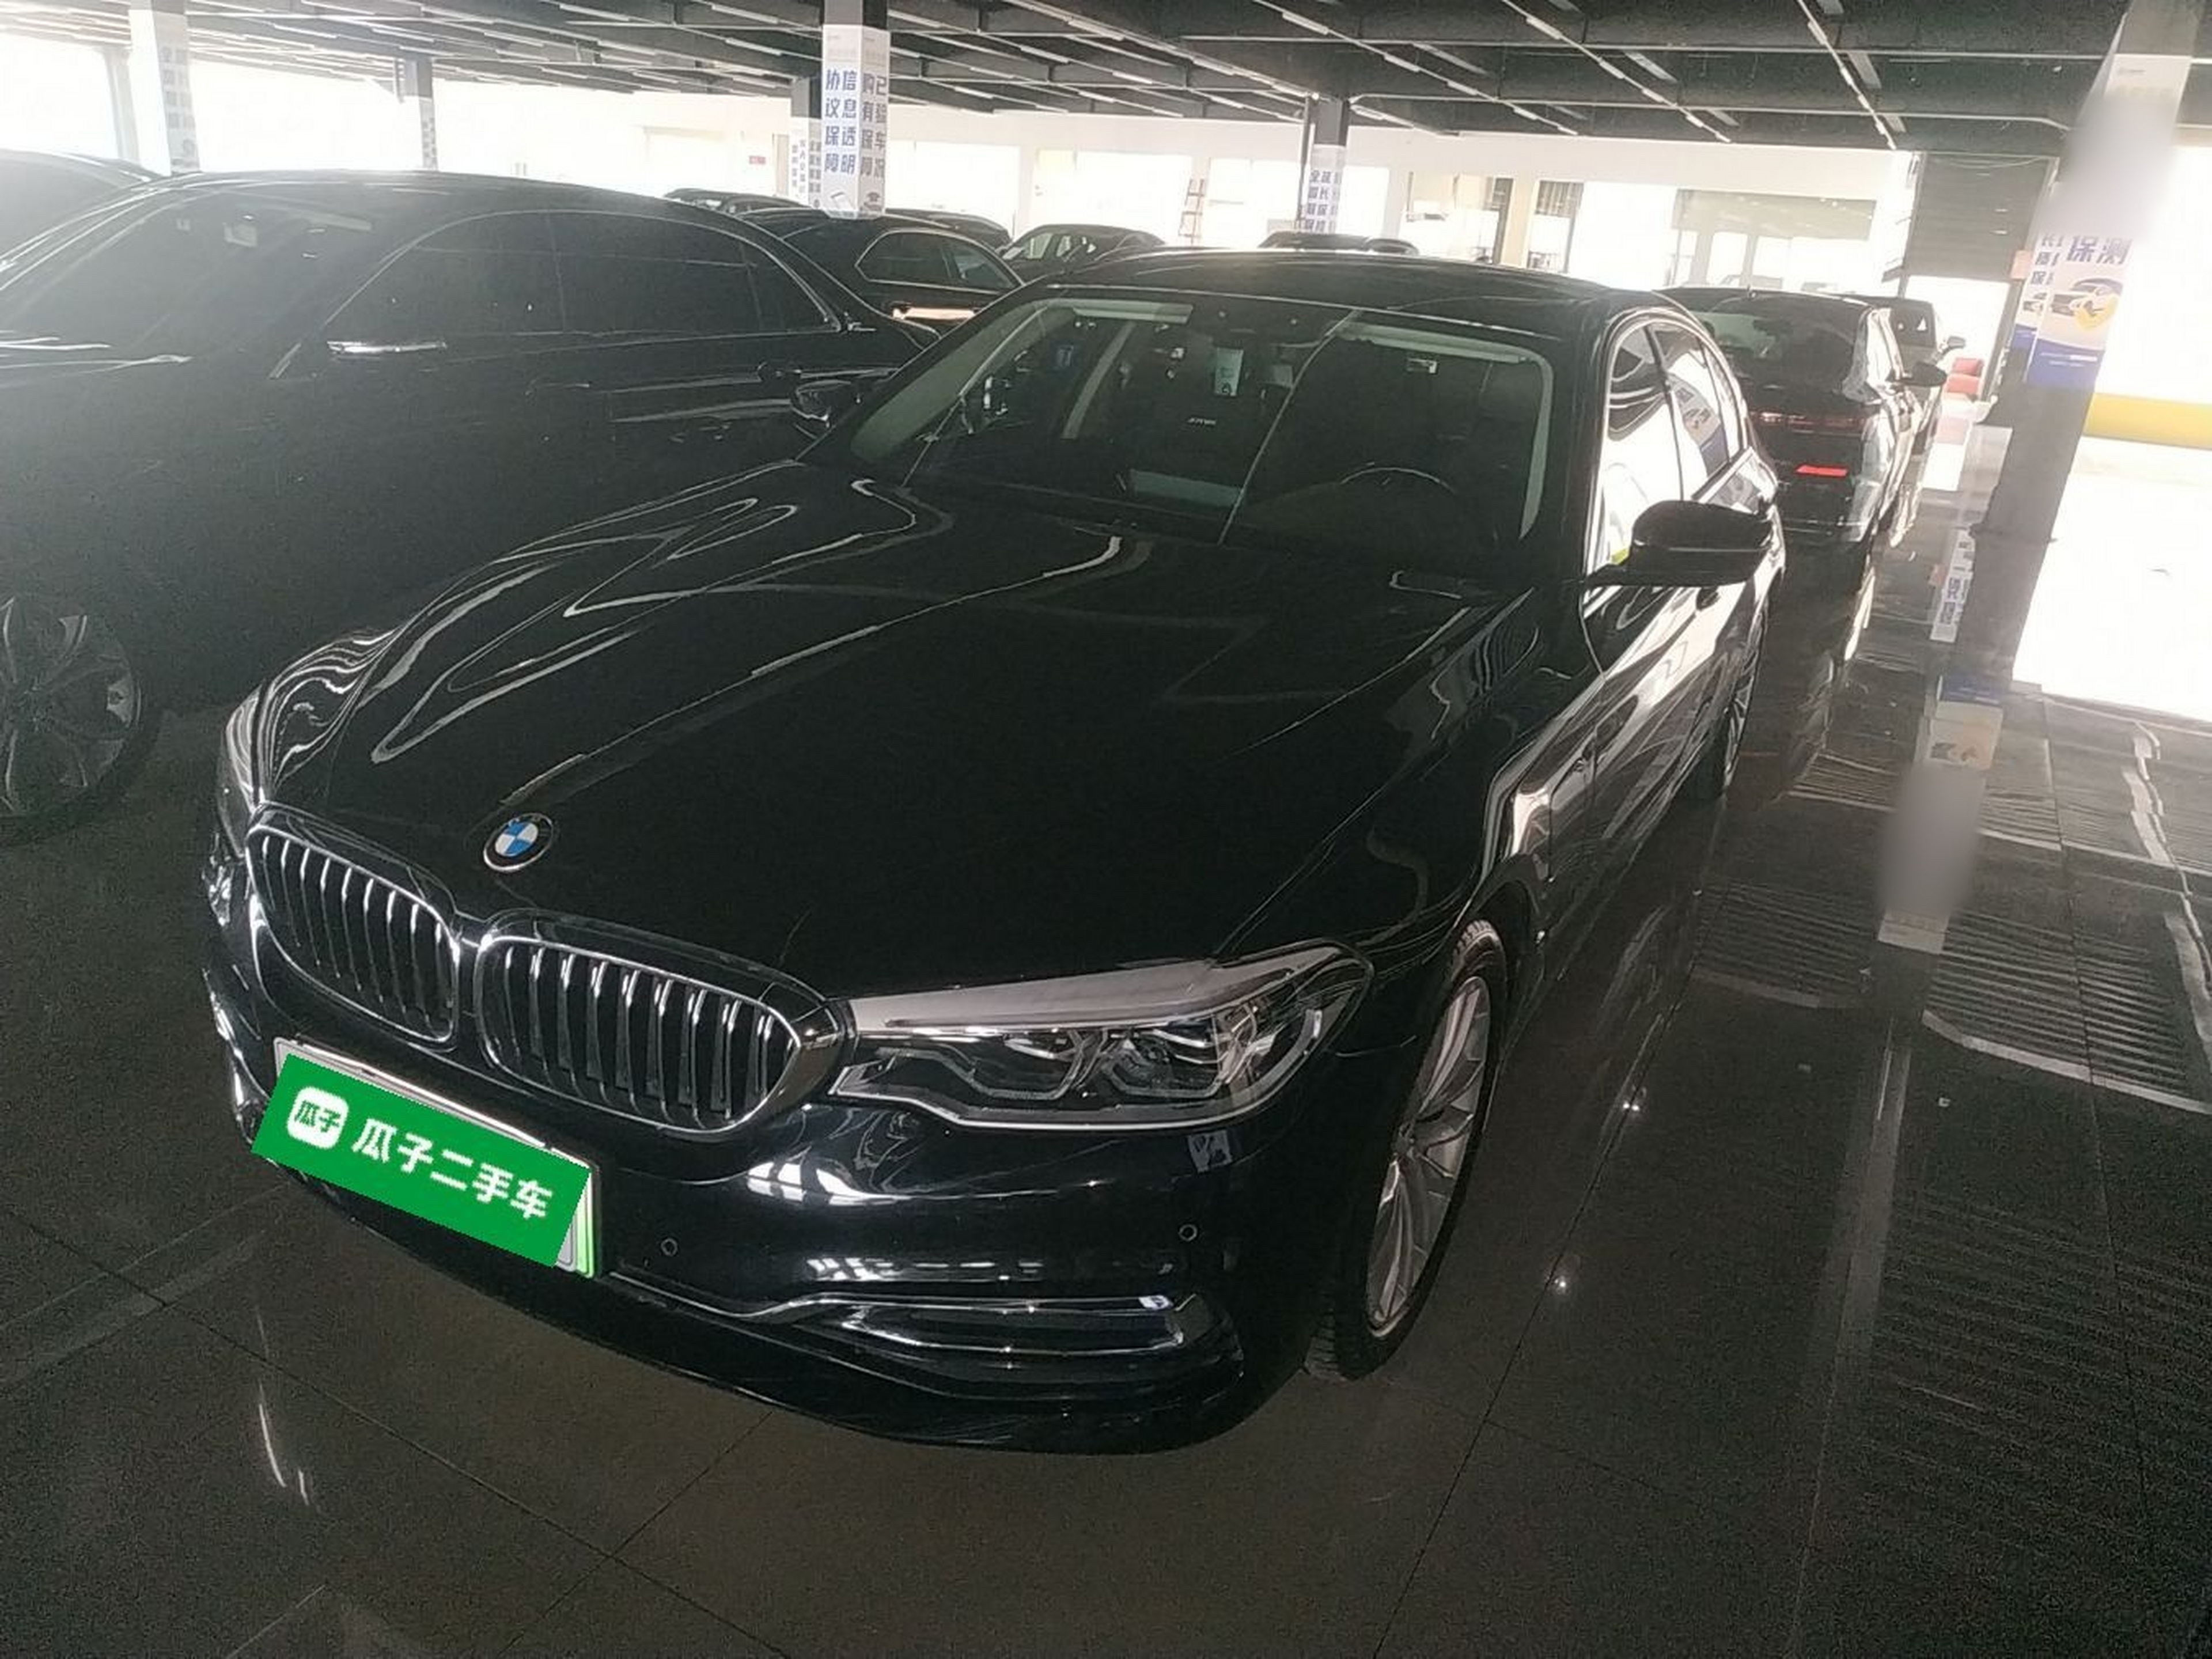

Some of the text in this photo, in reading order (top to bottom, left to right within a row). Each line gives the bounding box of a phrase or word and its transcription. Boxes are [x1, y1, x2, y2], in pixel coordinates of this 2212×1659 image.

[825, 69, 840, 172] 协议保障
[842, 70, 857, 174] 信息透明
